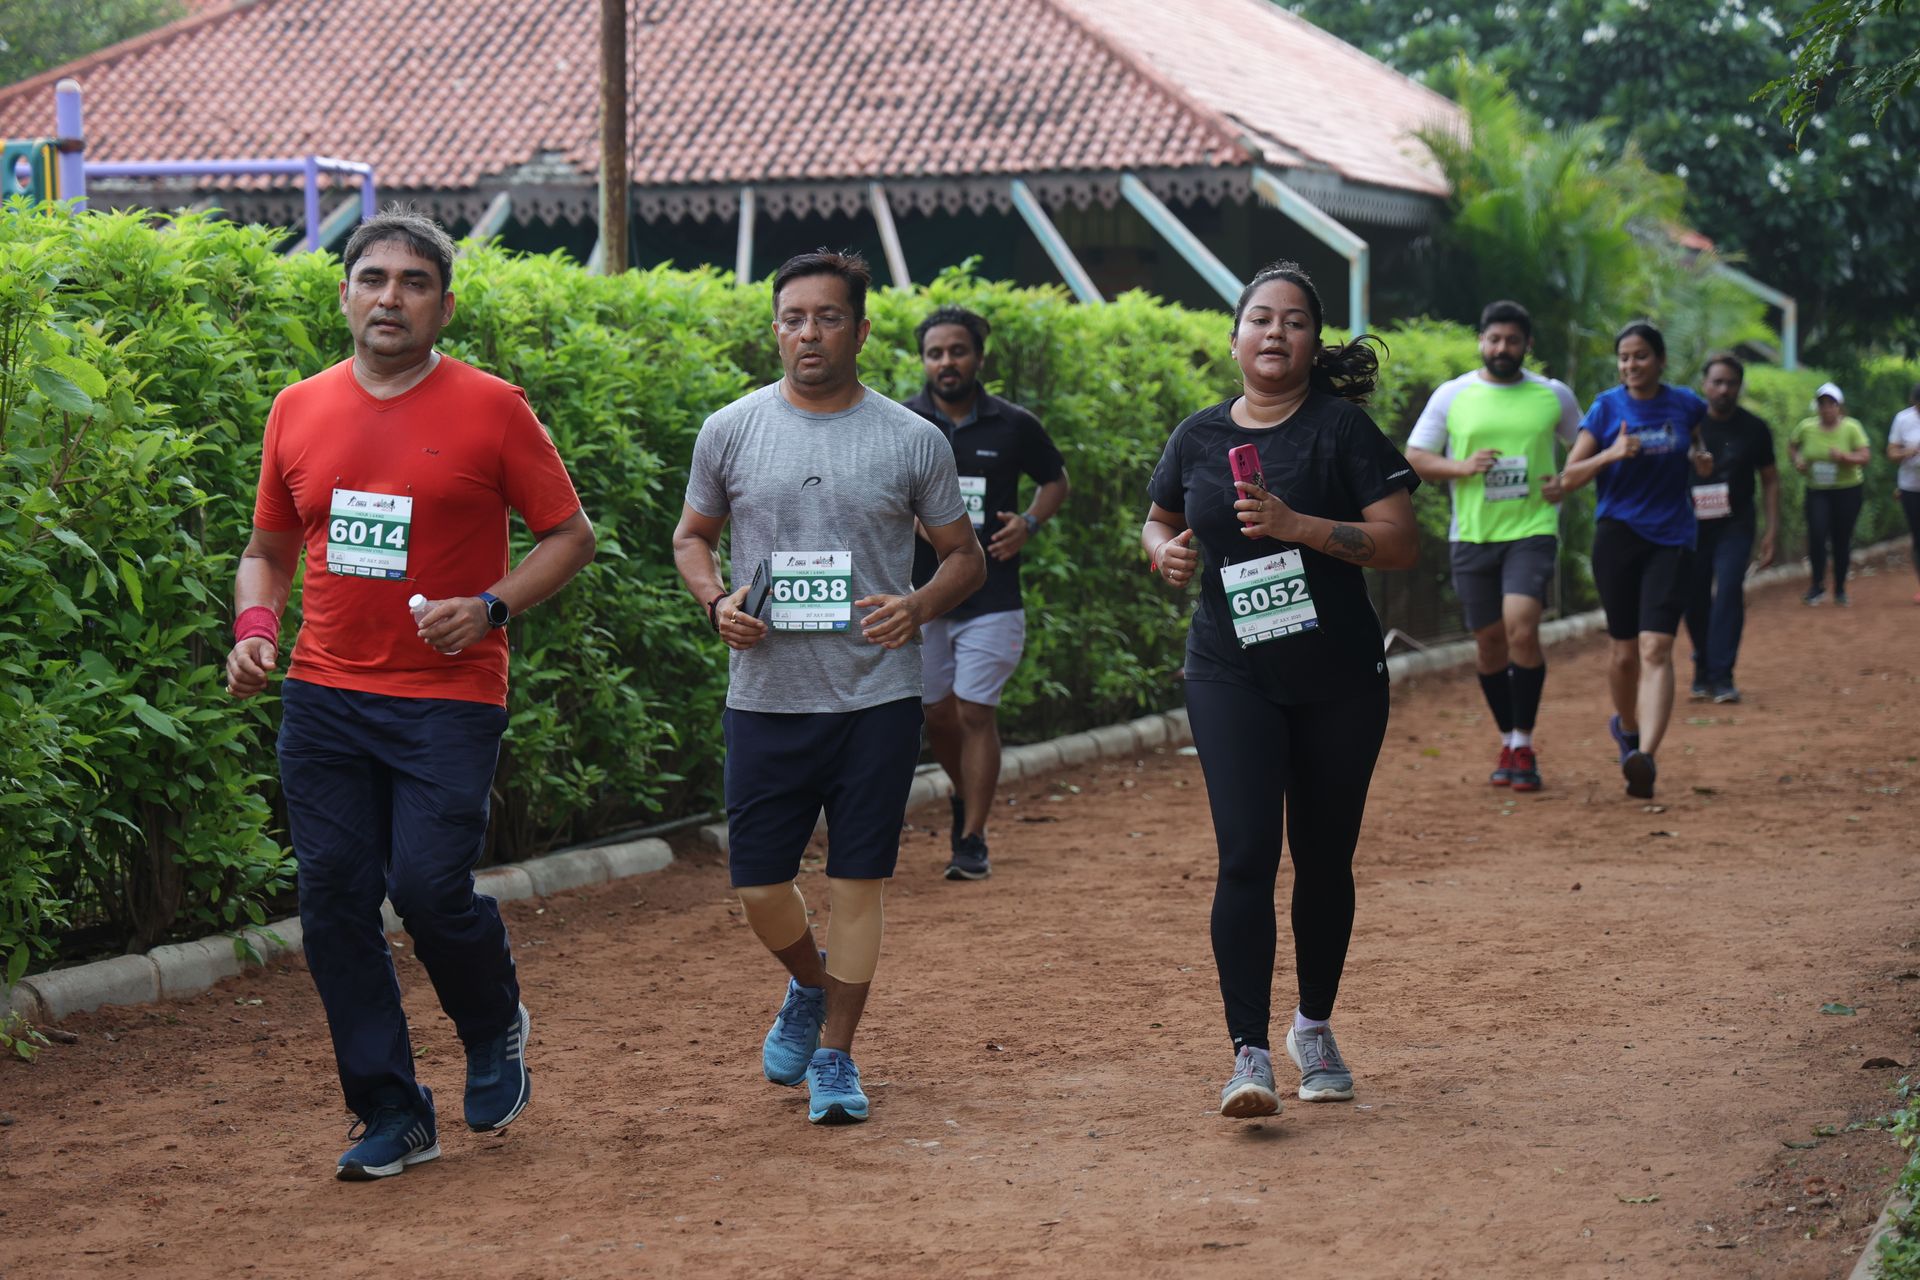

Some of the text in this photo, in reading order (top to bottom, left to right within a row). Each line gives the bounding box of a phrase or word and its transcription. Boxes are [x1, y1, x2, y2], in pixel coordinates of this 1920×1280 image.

[329, 518, 406, 549] 6014
[773, 579, 848, 602] 6038
[1232, 578, 1310, 616] 6052
